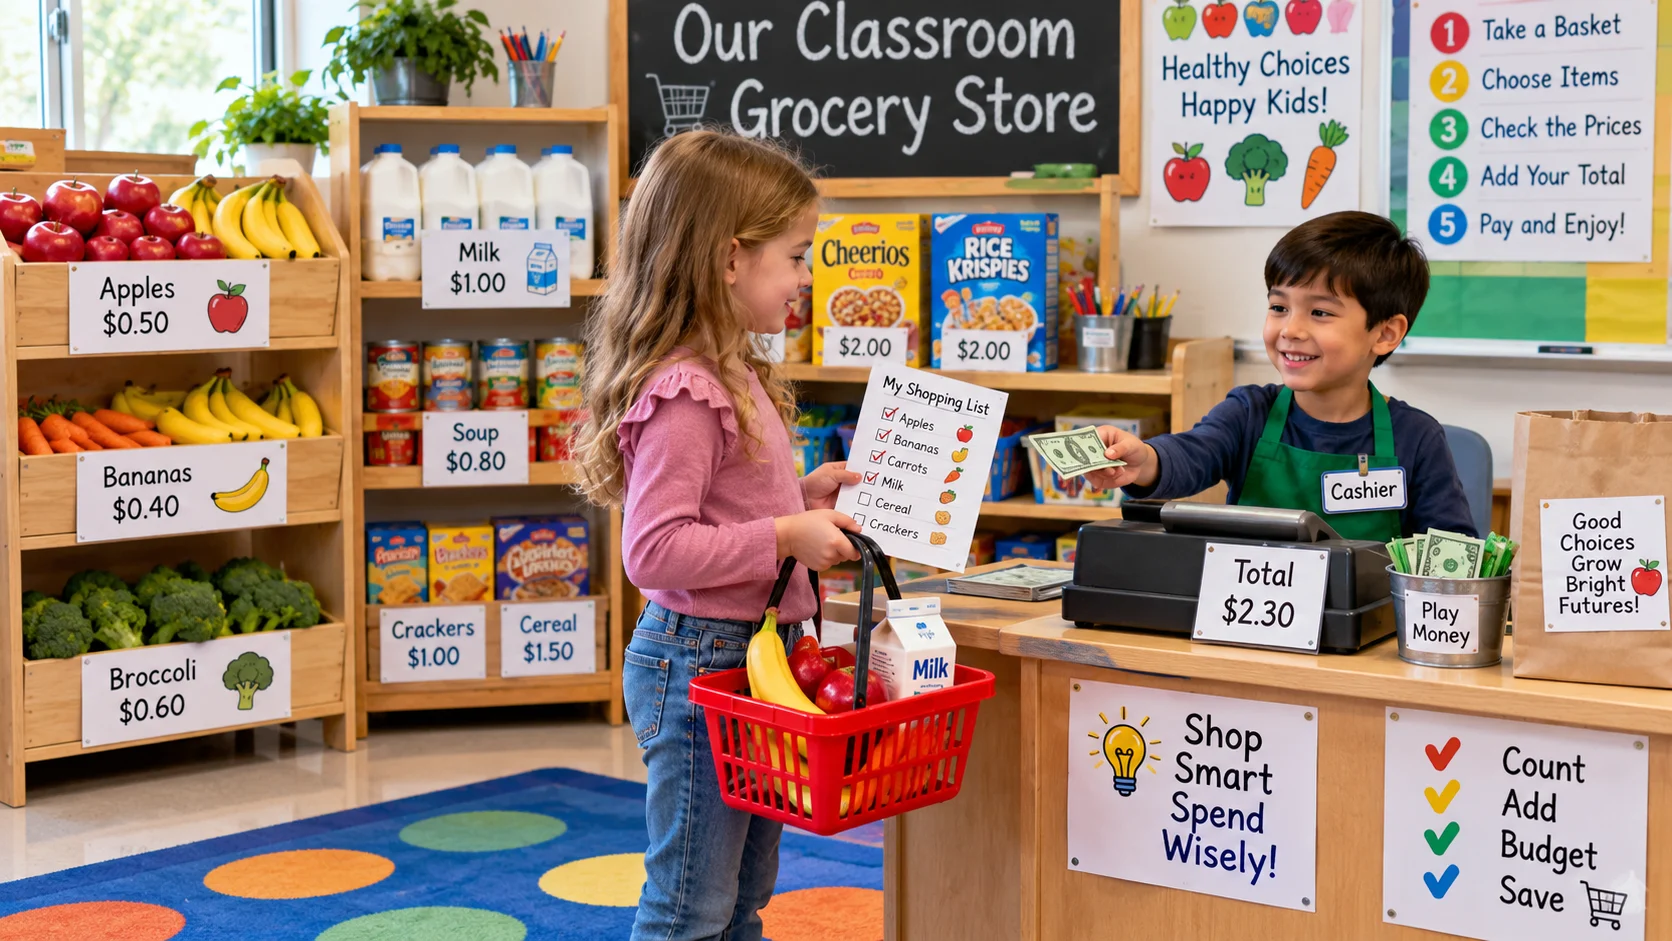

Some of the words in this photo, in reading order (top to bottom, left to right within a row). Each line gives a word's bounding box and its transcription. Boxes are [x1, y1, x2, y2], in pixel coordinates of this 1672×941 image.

[674, 3, 773, 64] Our
[797, 0, 1074, 61] Classroom
[1443, 19, 1455, 47] 1
[1482, 18, 1526, 40] Take
[1535, 24, 1546, 38] a
[1555, 13, 1621, 37] Basket
[1163, 52, 1250, 86] Healthy
[1260, 50, 1350, 77] Choices
[1441, 68, 1457, 95] 2
[1482, 68, 1551, 90] Choose
[1560, 66, 1618, 88] Items
[730, 78, 931, 156] Grocery
[953, 75, 1097, 134] Store
[1182, 91, 1256, 124] Happy
[1268, 86, 1327, 115] Kids!
[1440, 116, 1457, 143] 3
[1481, 116, 1538, 139] Check
[1545, 115, 1576, 137] the
[1585, 114, 1641, 136] Prices
[1439, 164, 1457, 190] 4
[1481, 164, 1518, 186] Add
[1527, 165, 1570, 186] Your
[1578, 163, 1625, 185] Total
[1440, 212, 1456, 238] 5
[1481, 213, 1513, 241] Pay
[1521, 212, 1556, 234] and
[1565, 212, 1624, 241] Enjoy!
[459, 241, 500, 262] Milk
[821, 240, 910, 267] Cheerios
[964, 237, 1012, 258] RICE
[451, 270, 505, 295] $1.00
[948, 259, 1029, 282] KRISPIES
[100, 275, 175, 307] Apples
[104, 310, 168, 338] $0.50
[839, 335, 891, 357] $2.00
[958, 338, 1010, 361] $2.00
[883, 376, 902, 396] My
[906, 382, 963, 412] Shopping
[967, 398, 989, 415] List
[899, 413, 934, 431] Apples
[453, 423, 499, 447] Soup
[894, 434, 939, 455] Bananas
[447, 450, 506, 474] $0.80
[888, 456, 927, 474] Carrots
[104, 466, 192, 488] Bananas
[881, 477, 903, 491] Milk
[1331, 481, 1397, 500] Cashier
[113, 495, 179, 524] $0.40
[876, 498, 912, 515] Cereal
[870, 519, 918, 539] Crackers
[1573, 511, 1621, 530] Good
[1561, 533, 1634, 551] Choices
[1235, 559, 1294, 587] Total
[1572, 555, 1622, 572] Grow
[1566, 575, 1625, 597] Bright
[1222, 594, 1294, 628] $2.30
[1423, 601, 1459, 626] Play
[1559, 596, 1638, 614] Futures!
[392, 618, 475, 639] Crackers
[520, 613, 576, 634] Cereal
[1413, 623, 1470, 649] Money
[408, 646, 459, 669] $1.00
[524, 641, 573, 664] $1.50
[110, 658, 196, 691] Broccoli
[913, 657, 948, 680] Milk
[120, 694, 185, 726] $0.60
[1184, 713, 1262, 762] Shop
[1175, 751, 1273, 795] Smart
[1503, 746, 1585, 783] Count
[1170, 791, 1265, 834] Spend
[1502, 789, 1556, 823] Add
[1162, 828, 1277, 886] Wisely!
[1502, 829, 1597, 875] Budget
[1500, 875, 1564, 912] Save
